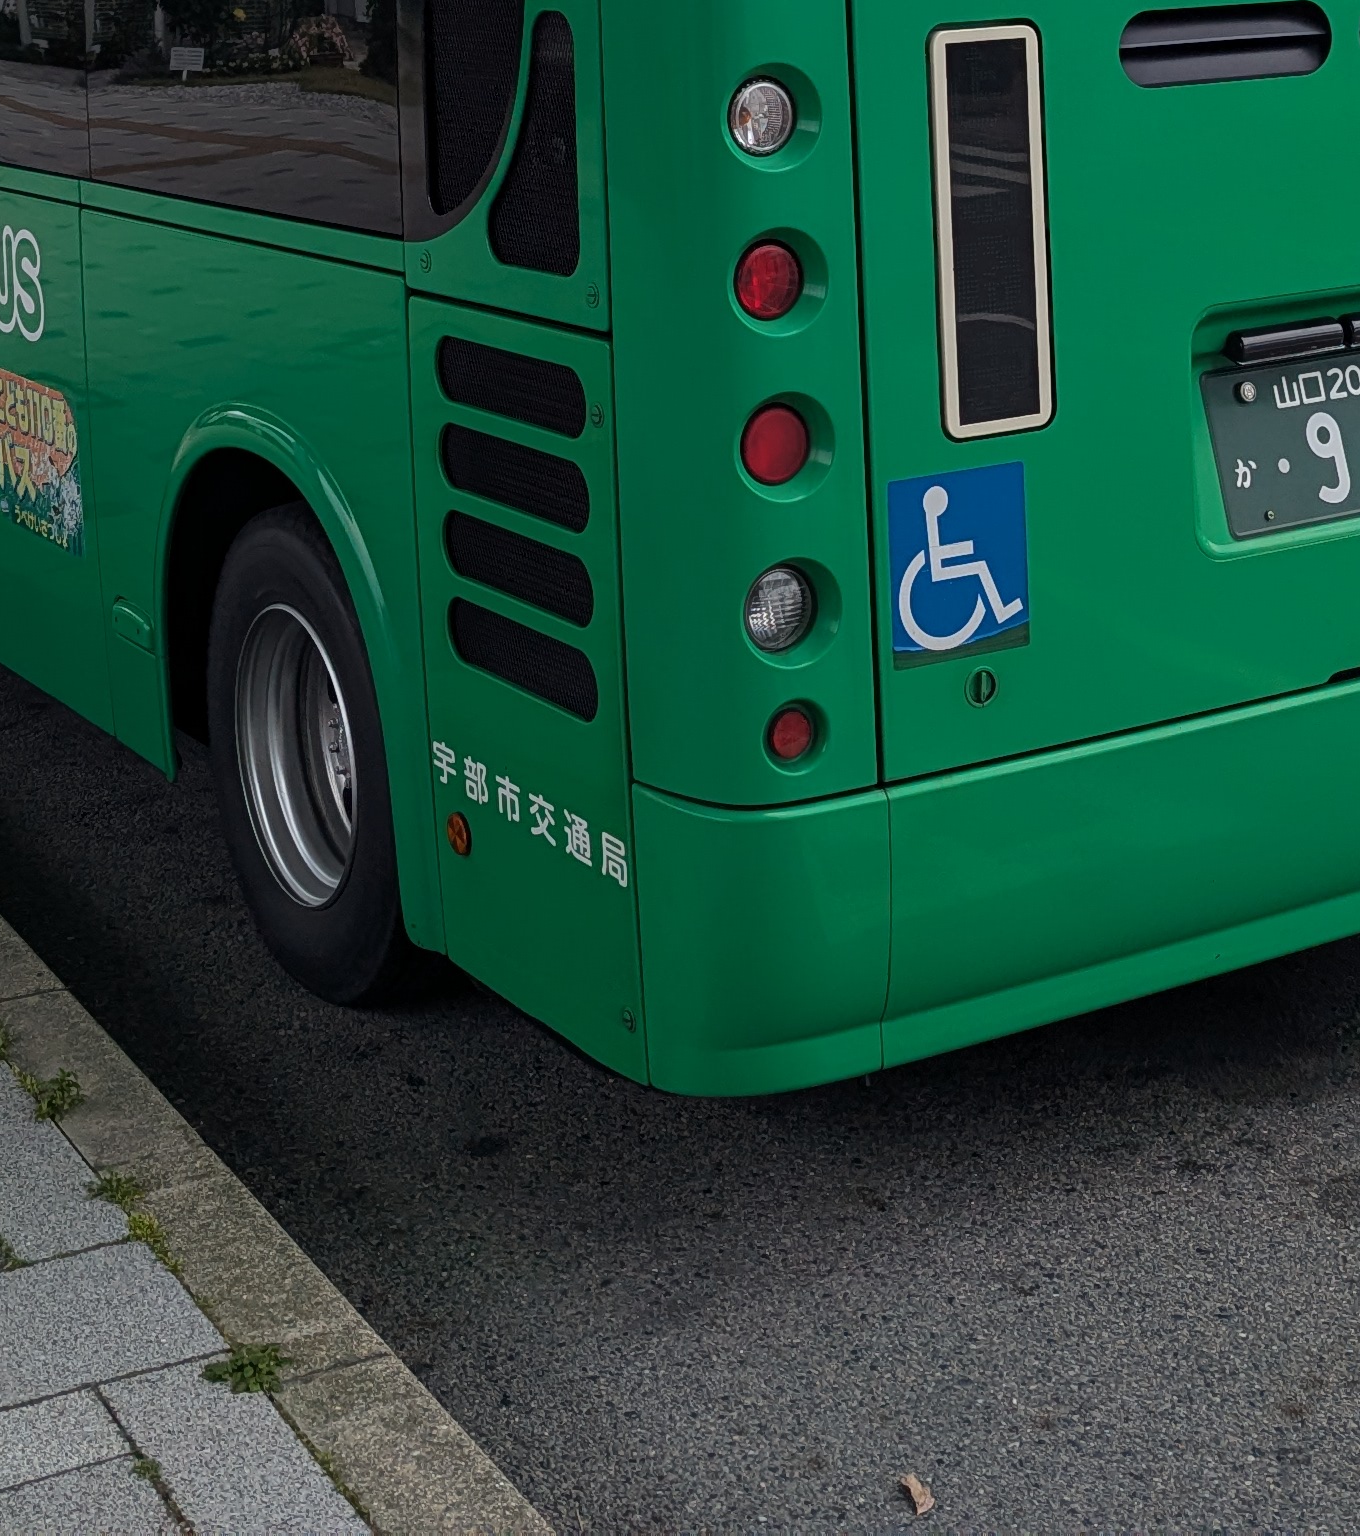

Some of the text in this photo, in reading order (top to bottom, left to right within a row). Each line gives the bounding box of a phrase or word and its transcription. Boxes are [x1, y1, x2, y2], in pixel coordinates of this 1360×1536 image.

[432, 740, 628, 888] 宇部市交通局
